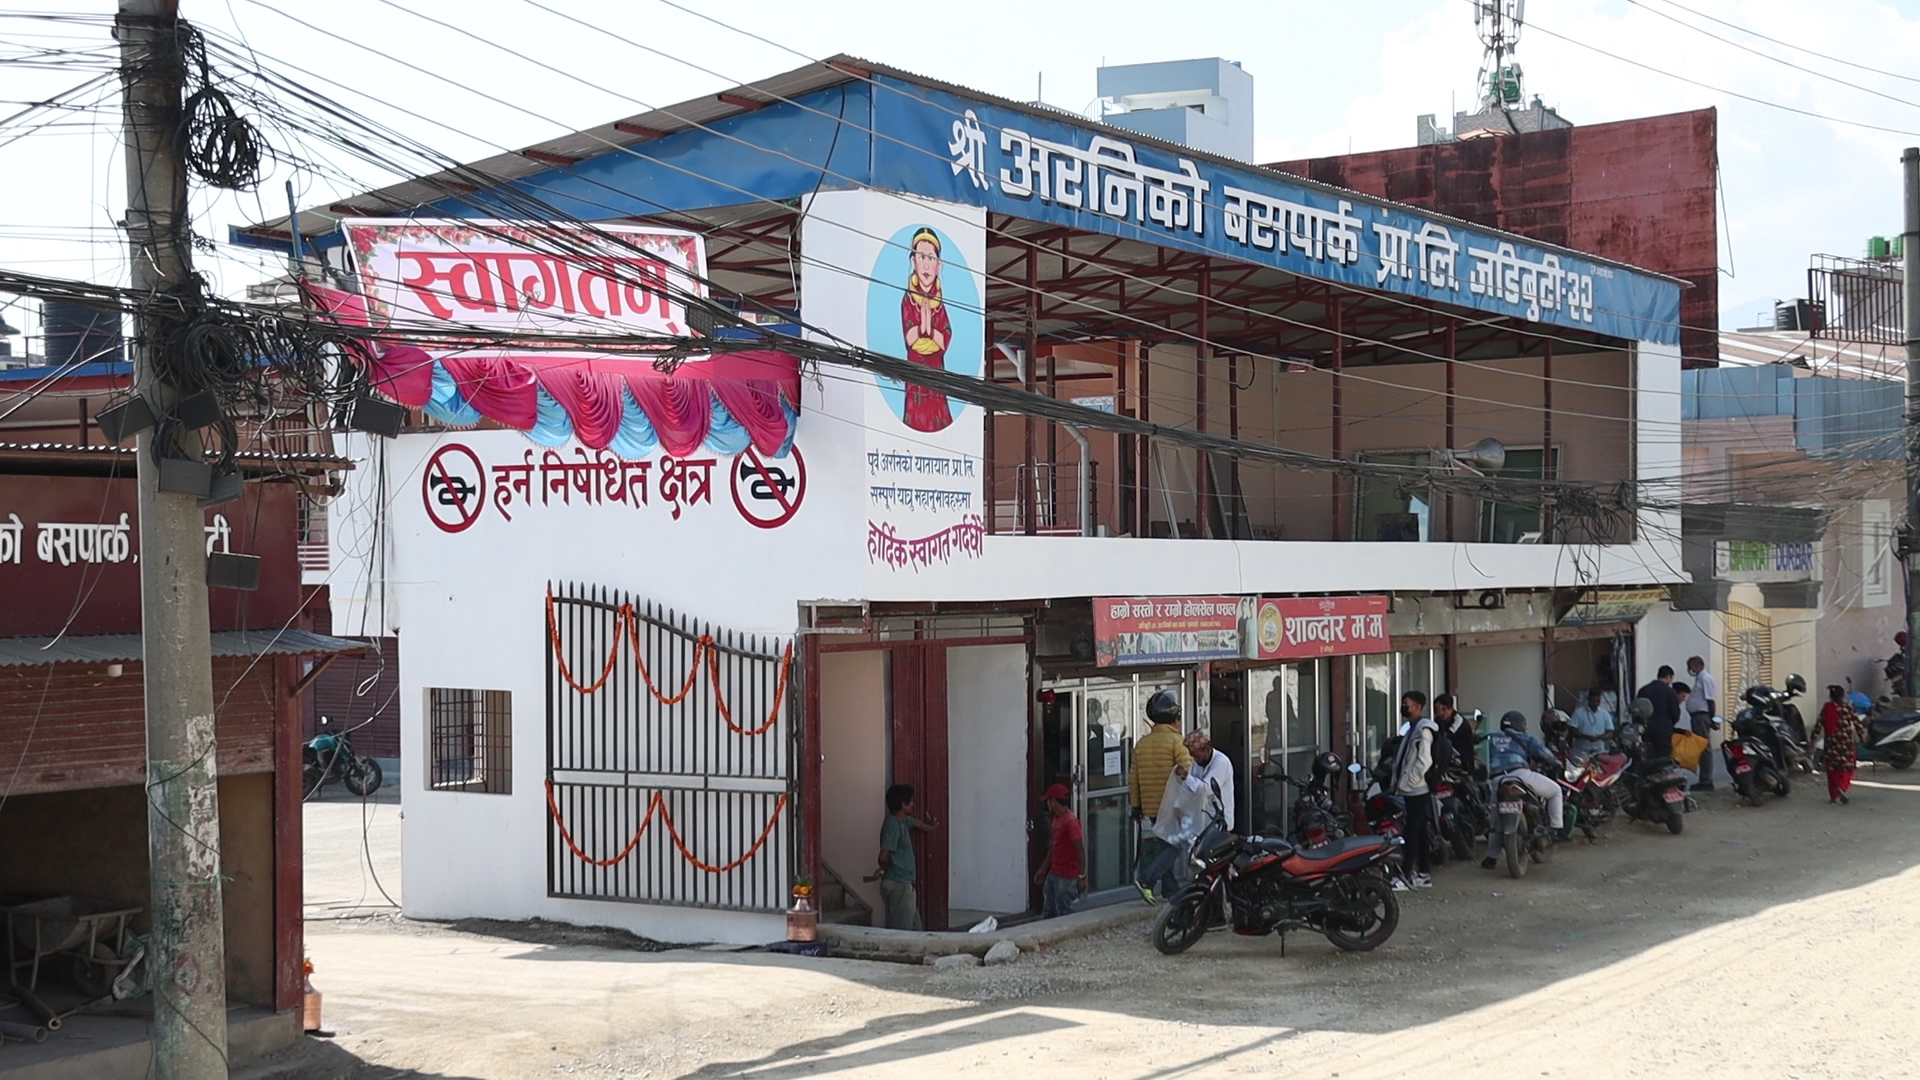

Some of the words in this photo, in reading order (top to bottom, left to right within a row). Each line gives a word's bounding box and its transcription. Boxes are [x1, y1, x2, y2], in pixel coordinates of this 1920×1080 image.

[948, 109, 989, 191] श्री
[1000, 127, 1210, 234] अरनिको
[1223, 185, 1363, 266] बसपार्क
[395, 251, 681, 335] स्वागतम्
[491, 448, 536, 522] हर्न
[539, 447, 653, 510] निषेधित
[659, 454, 718, 521] क्षत्र
[867, 448, 880, 477] पूर्व
[880, 449, 914, 474] अरनिको
[914, 455, 951, 478] यातायात
[869, 481, 896, 512] सम्पूर्ण
[867, 518, 908, 573] हार्दिक
[908, 527, 951, 574] स्वागत
[1110, 600, 1130, 619] हाम्रो
[1132, 600, 1154, 618] सस्तो
[1155, 604, 1162, 618] र
[1164, 600, 1182, 618] राम्रो
[1184, 599, 1215, 617] होलसेल
[1216, 603, 1237, 617] पसल
[1285, 614, 1347, 646] शान्दार
